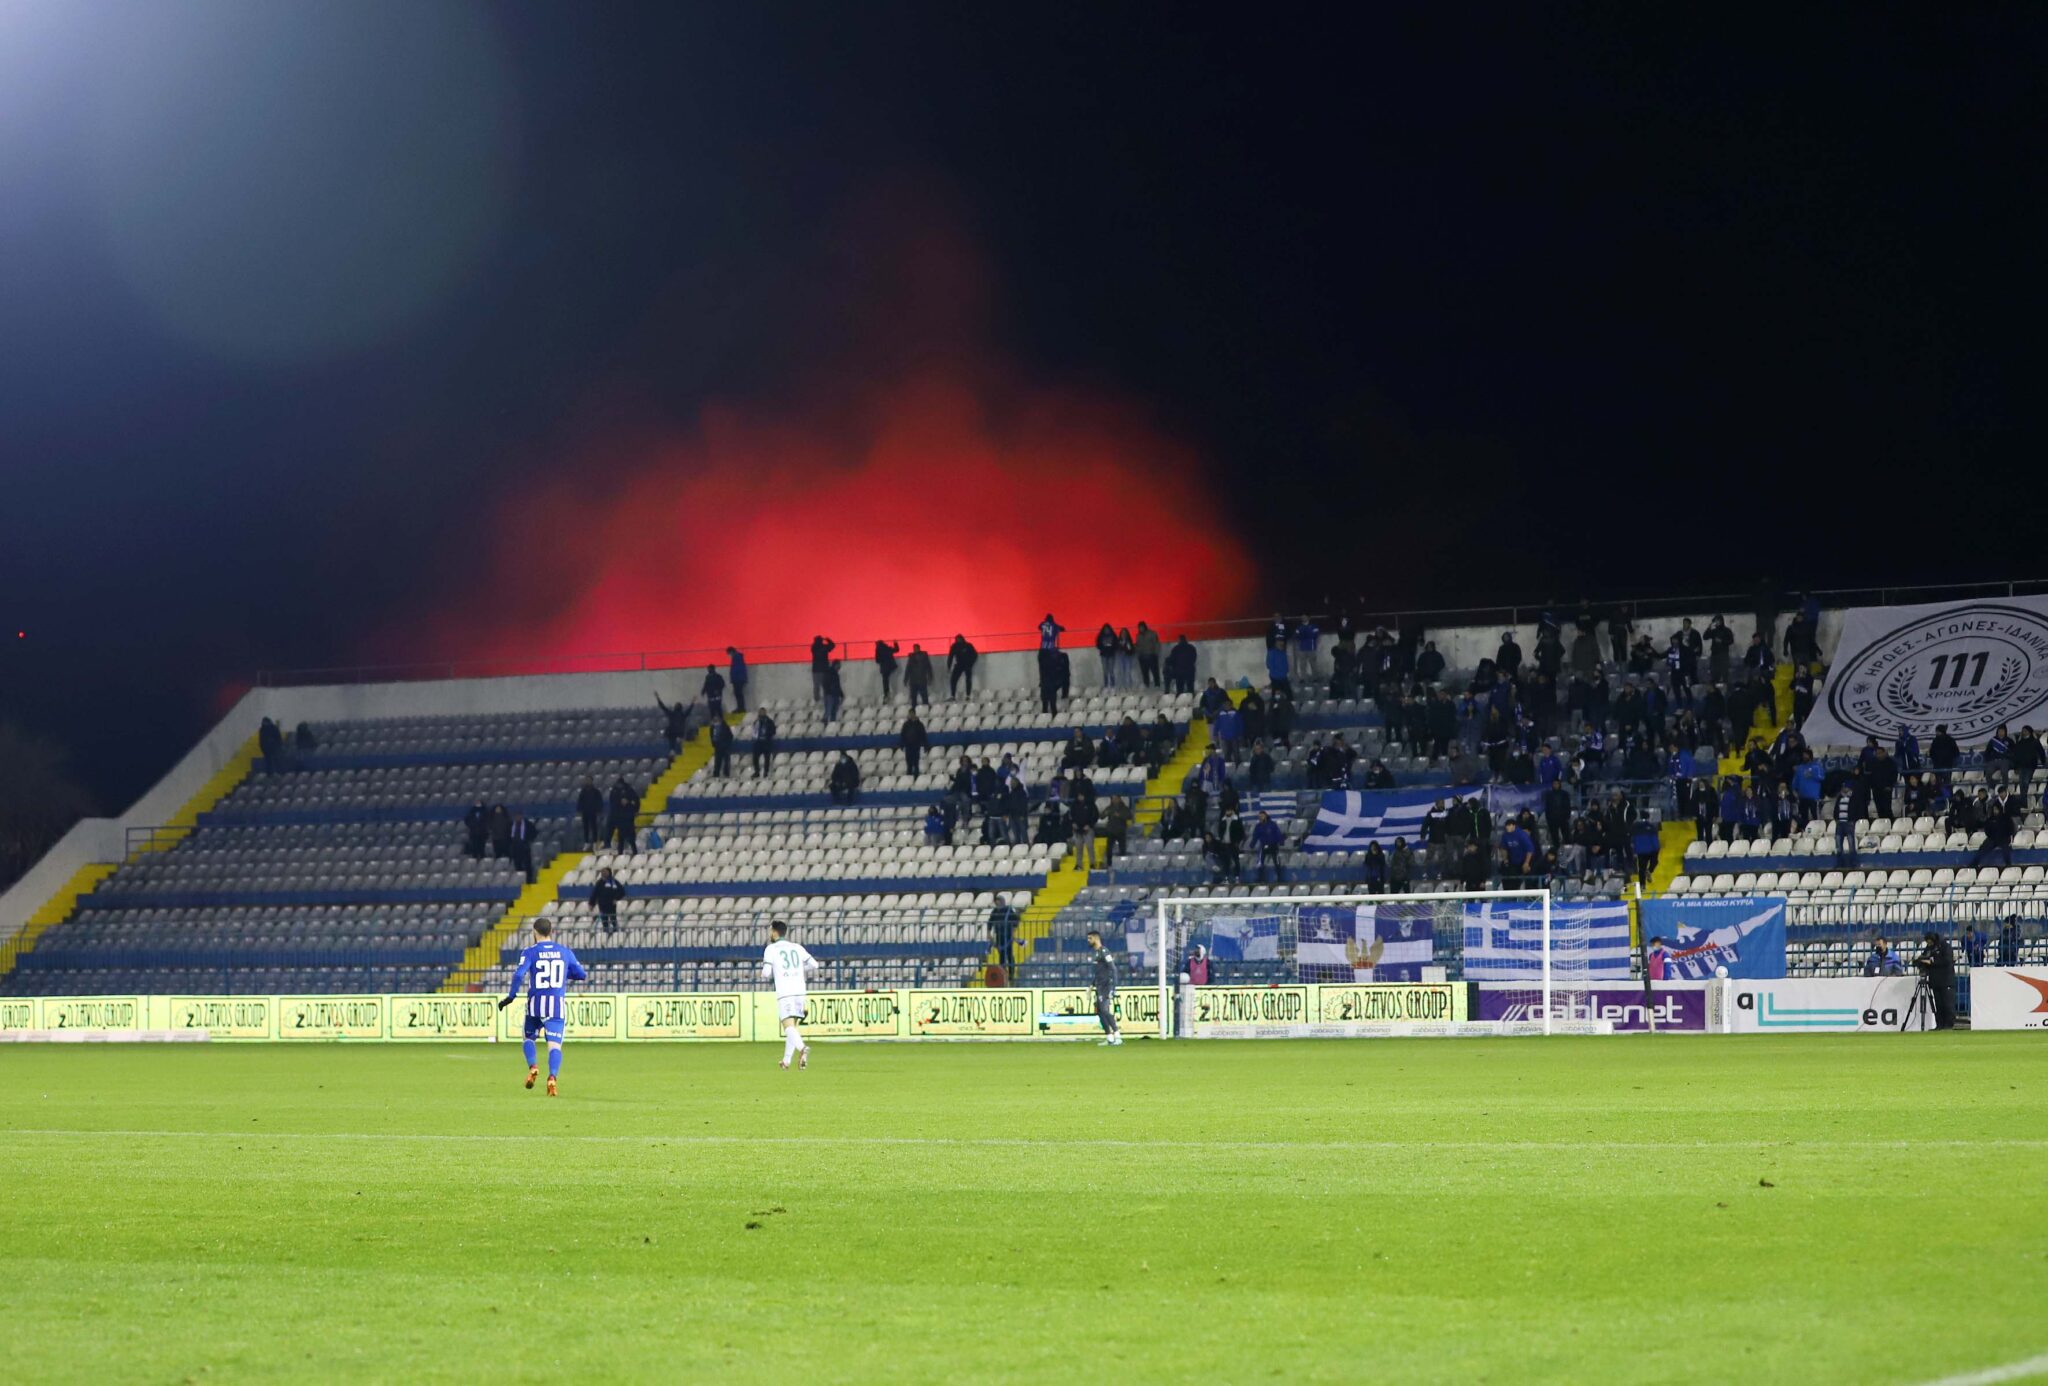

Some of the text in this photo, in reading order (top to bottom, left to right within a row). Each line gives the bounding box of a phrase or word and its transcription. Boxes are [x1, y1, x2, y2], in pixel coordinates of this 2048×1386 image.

[1928, 651, 1990, 690] 111
[1926, 689, 1976, 699] ΧΡΟΝΙΑ
[780, 949, 800, 969] 30
[535, 959, 565, 989] 20
[346, 1003, 378, 1027] GROUP
[461, 1002, 493, 1026] GROUP
[577, 1001, 611, 1026] GROUP
[701, 1001, 736, 1026] GROUP
[857, 997, 893, 1025] GROUP
[990, 996, 1027, 1023] GROUP
[1125, 994, 1160, 1021] GROU
[1262, 993, 1300, 1021] GROUP
[1405, 992, 1447, 1020] GROUP
[1527, 995, 1683, 1023] cablenet
